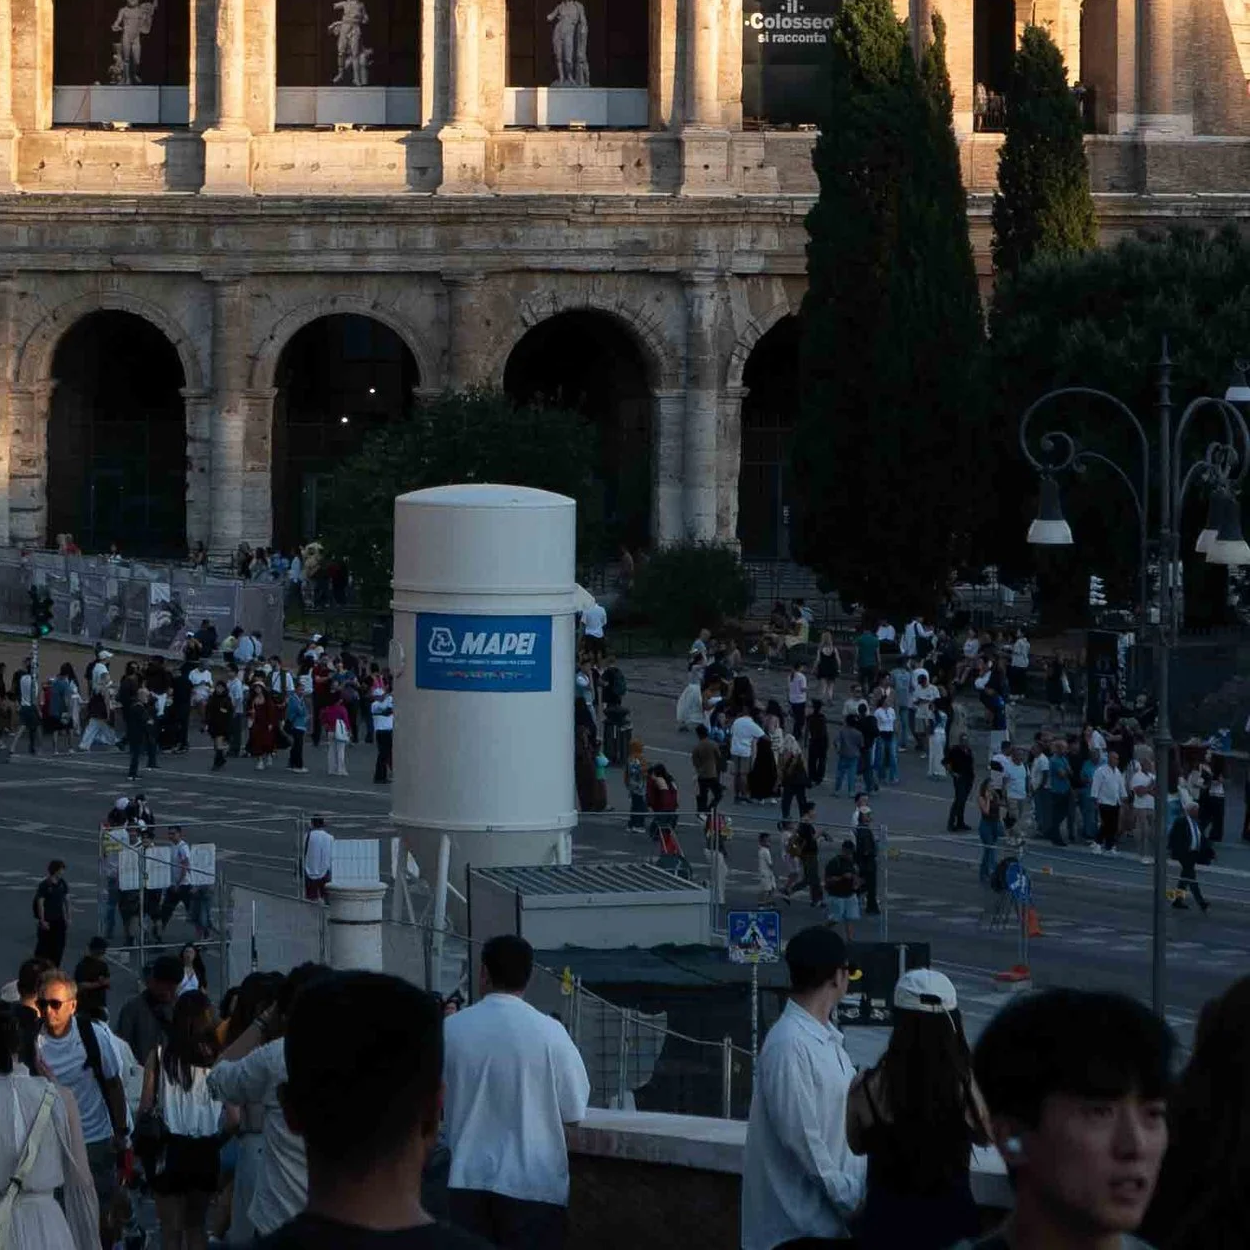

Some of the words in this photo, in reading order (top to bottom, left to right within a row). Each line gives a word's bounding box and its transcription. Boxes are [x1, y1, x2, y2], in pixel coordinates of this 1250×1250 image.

[750, 12, 835, 30] Colosseo
[757, 31, 770, 43] si
[772, 31, 827, 43] racconta
[460, 632, 537, 655] MAPEI
